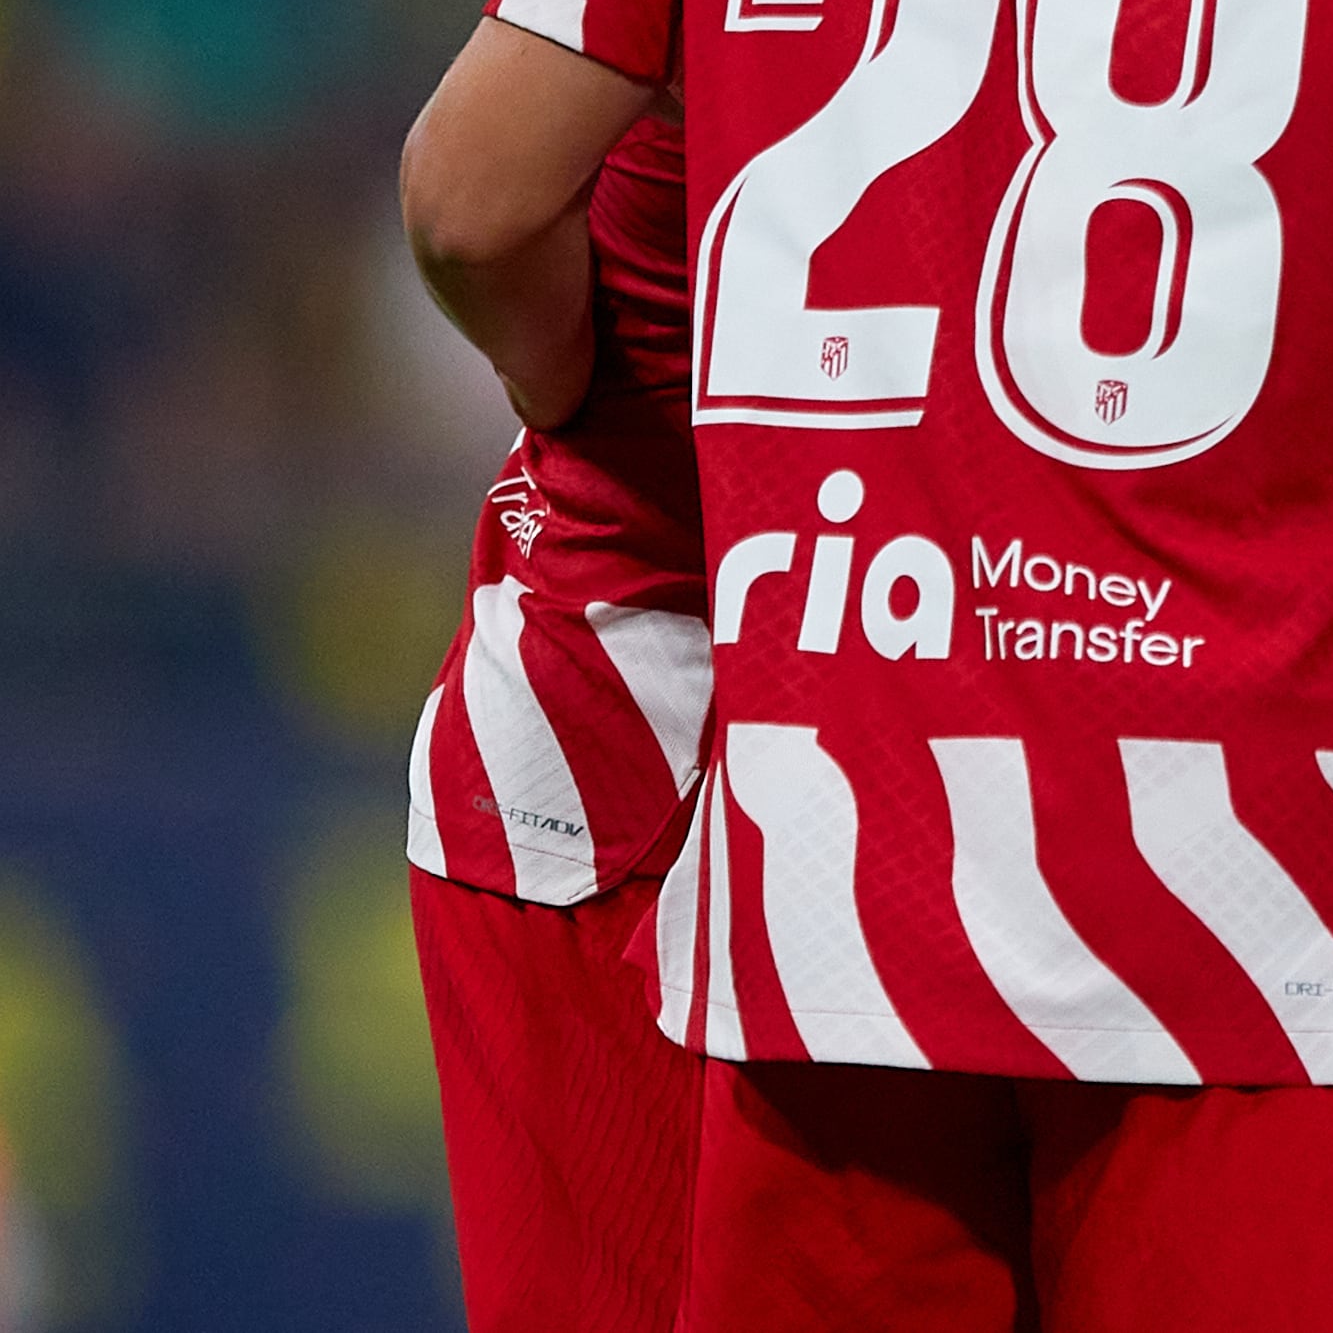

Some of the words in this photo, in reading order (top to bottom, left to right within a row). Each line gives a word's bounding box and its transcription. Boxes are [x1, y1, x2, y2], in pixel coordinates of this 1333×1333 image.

[712, 469, 955, 661] ria
[970, 534, 1172, 622] Money
[974, 606, 1206, 669] Transfer
